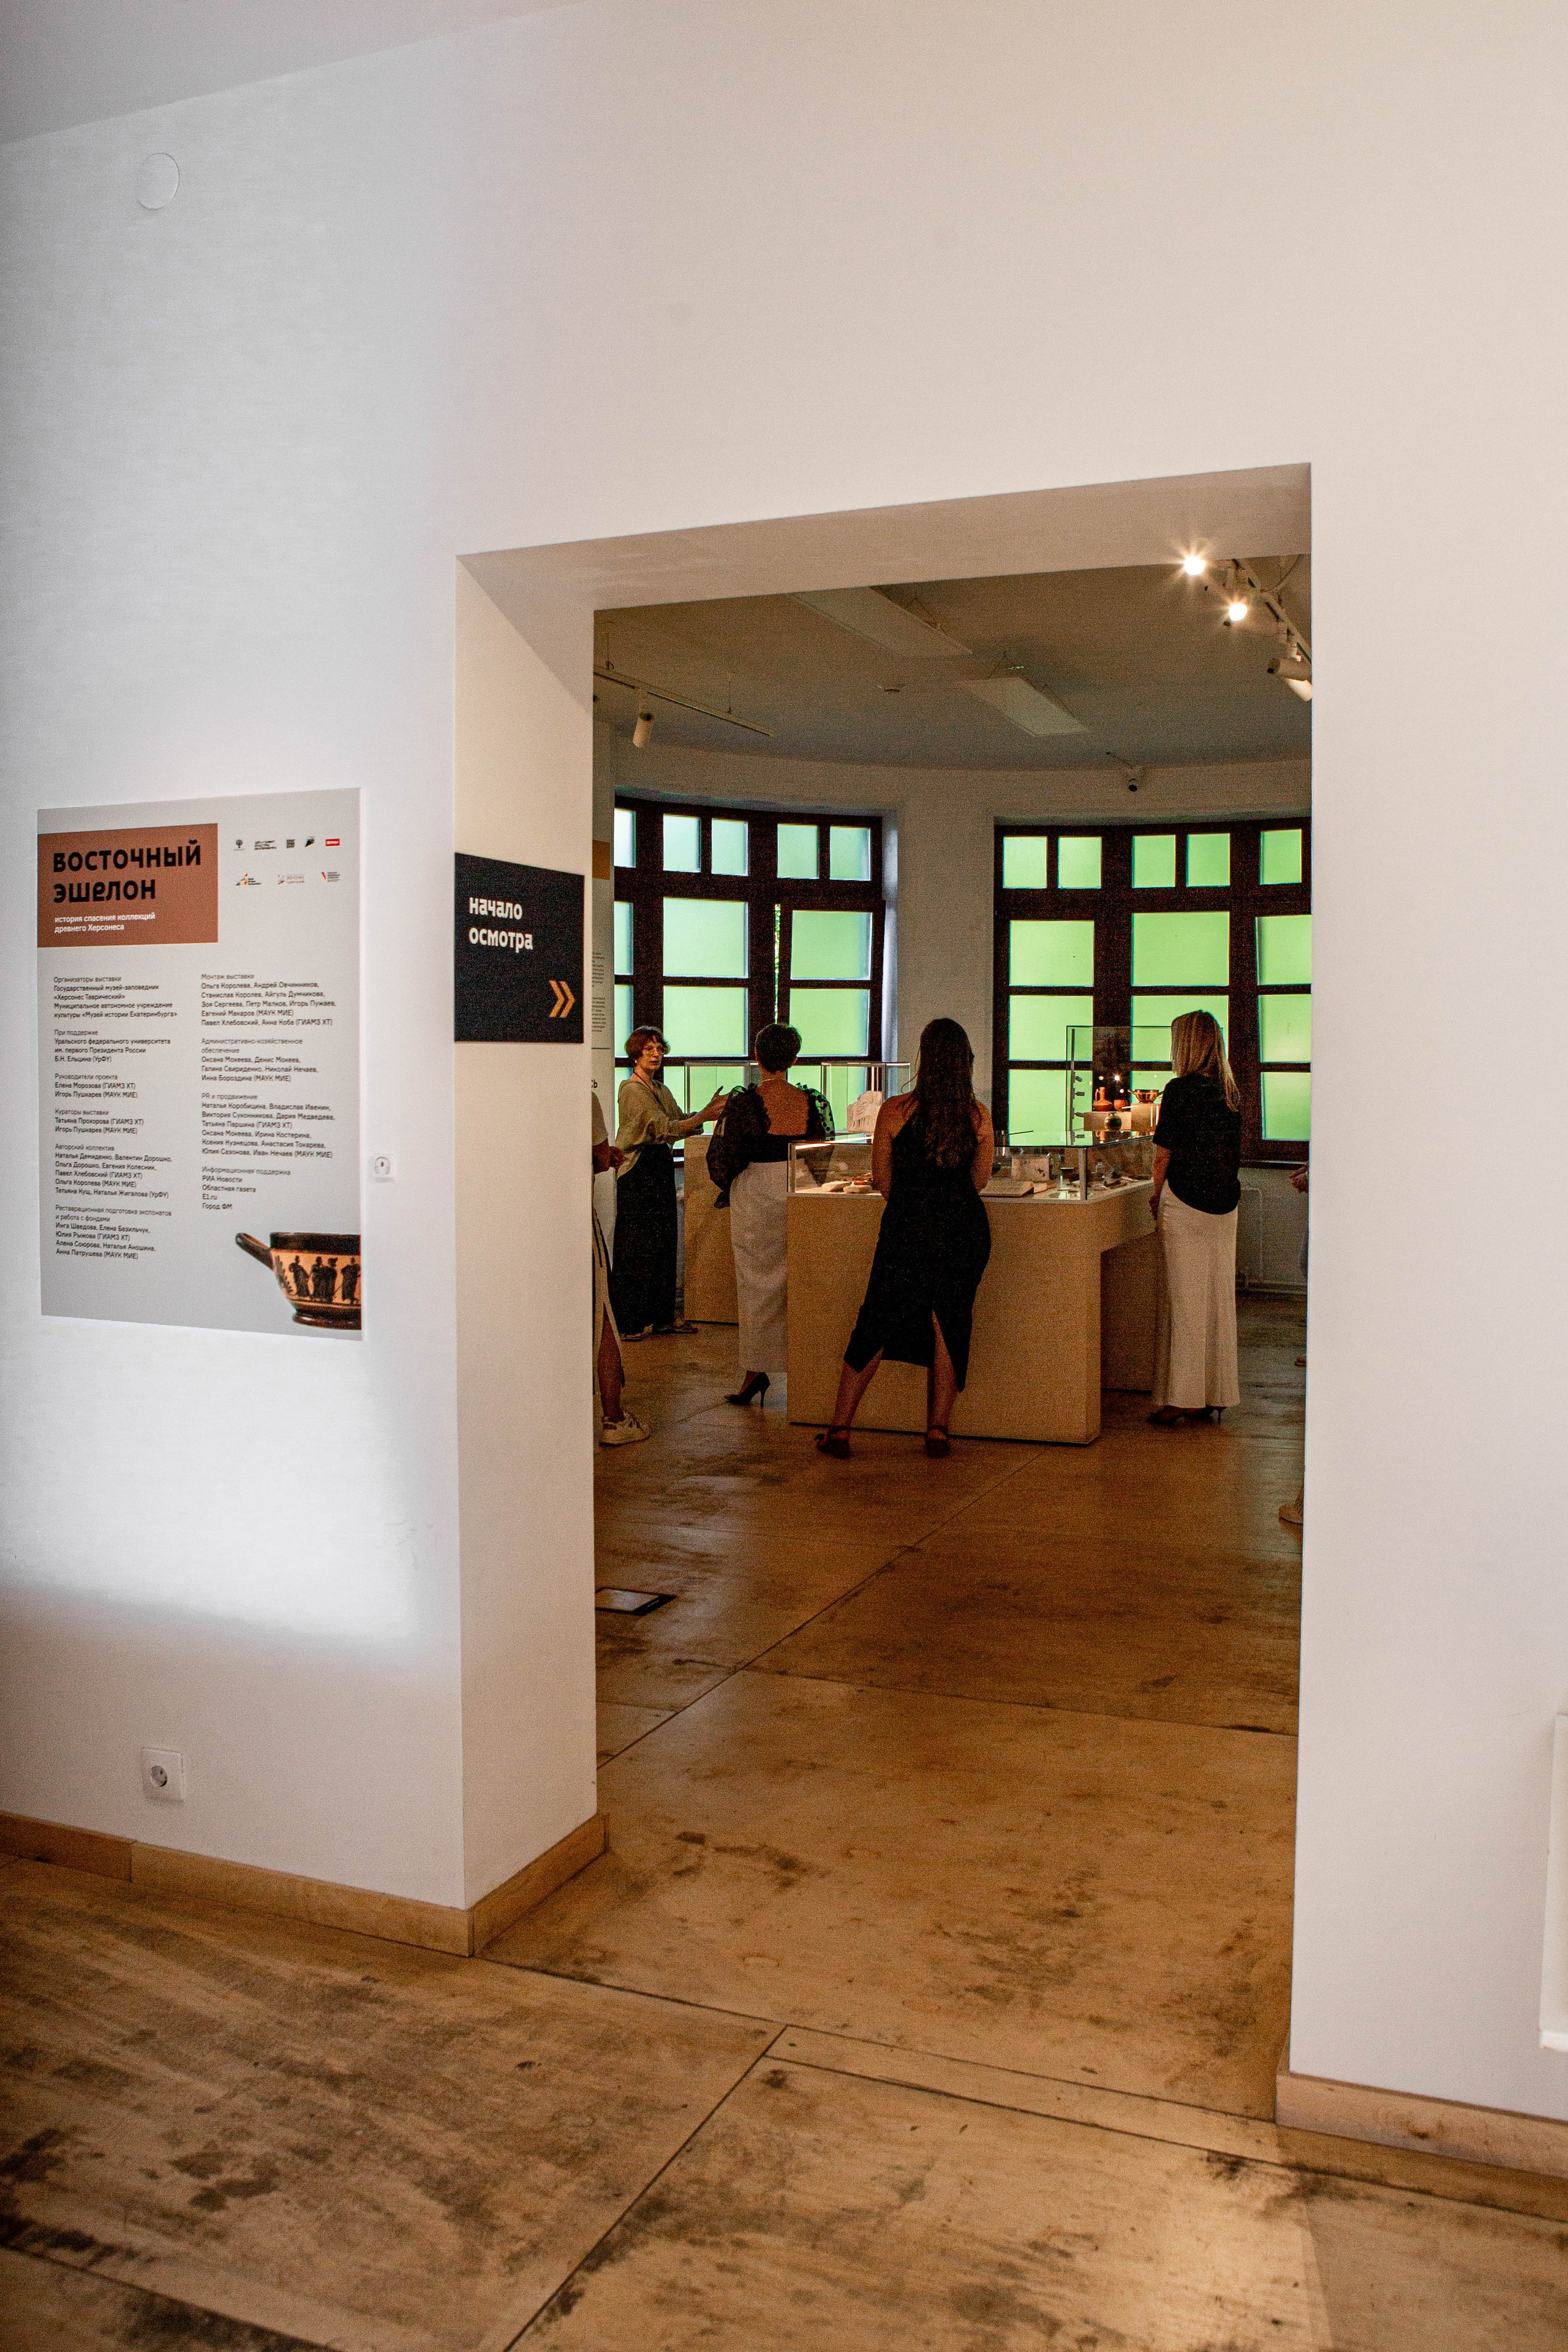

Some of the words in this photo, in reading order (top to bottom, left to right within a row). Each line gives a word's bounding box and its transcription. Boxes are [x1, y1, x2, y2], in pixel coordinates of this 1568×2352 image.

[469, 897, 522, 919] начало
[118, 912, 156, 921] коллекций
[88, 924, 125, 932] Херсонеса
[469, 927, 533, 954] осмотра
